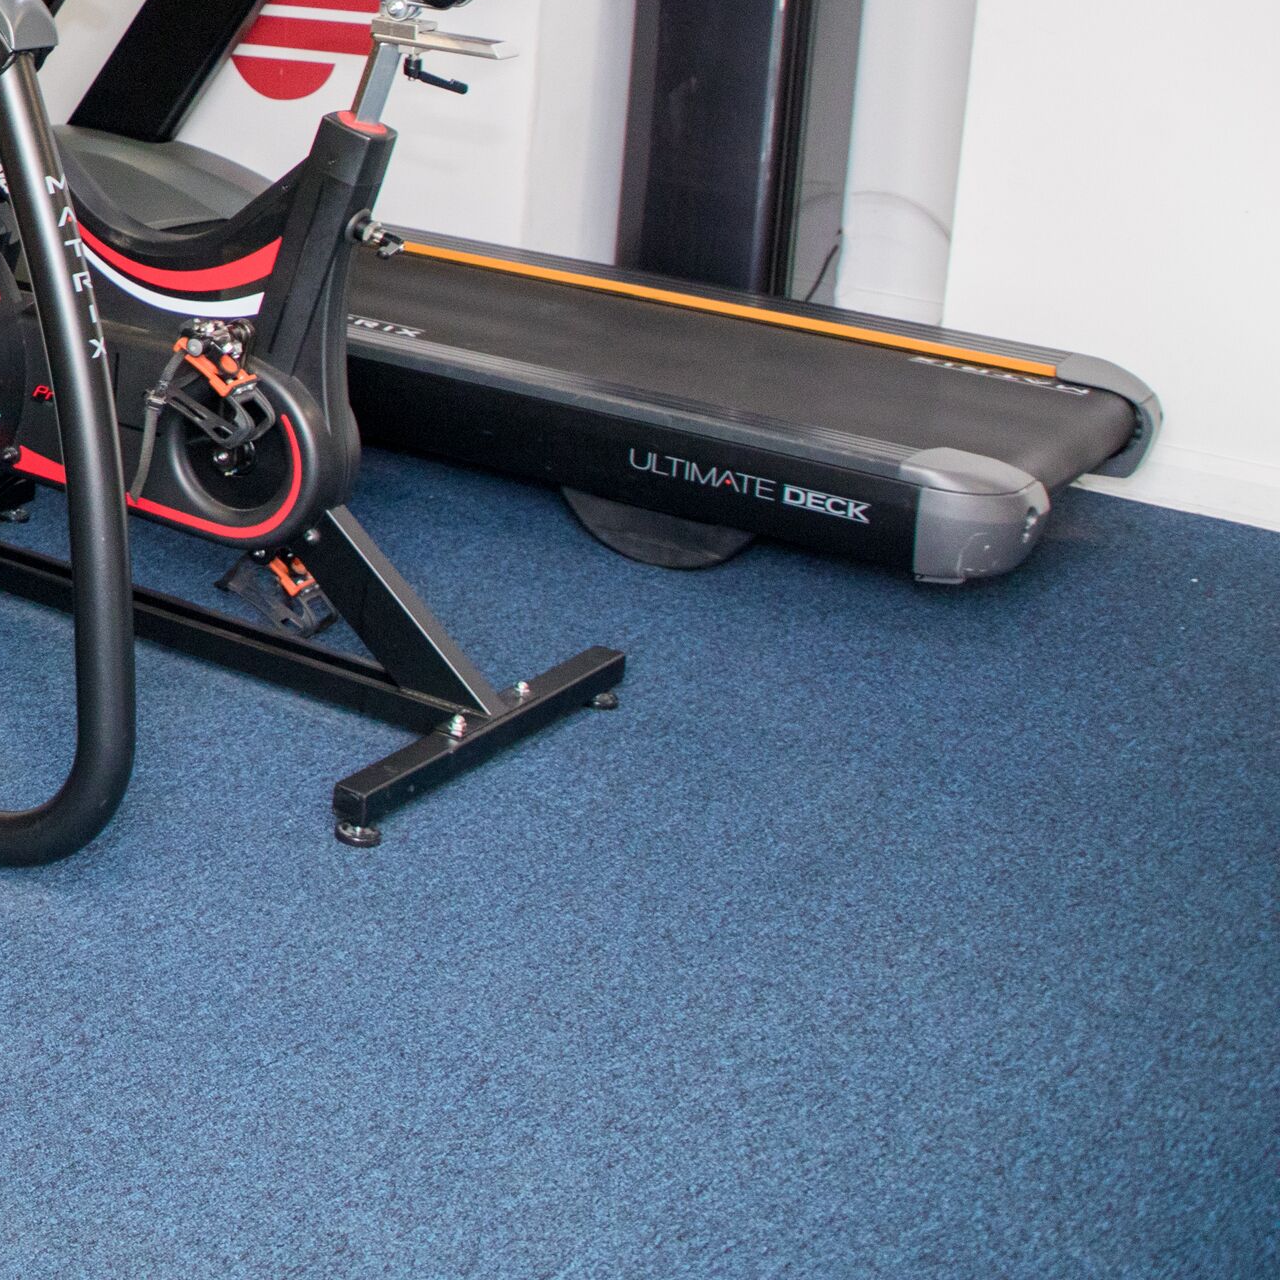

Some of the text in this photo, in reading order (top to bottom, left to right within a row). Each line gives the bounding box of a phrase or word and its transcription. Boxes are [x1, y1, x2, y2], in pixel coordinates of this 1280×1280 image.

[45, 173, 109, 359] MATRIX
[628, 448, 871, 522] ULTIMATE DECK
